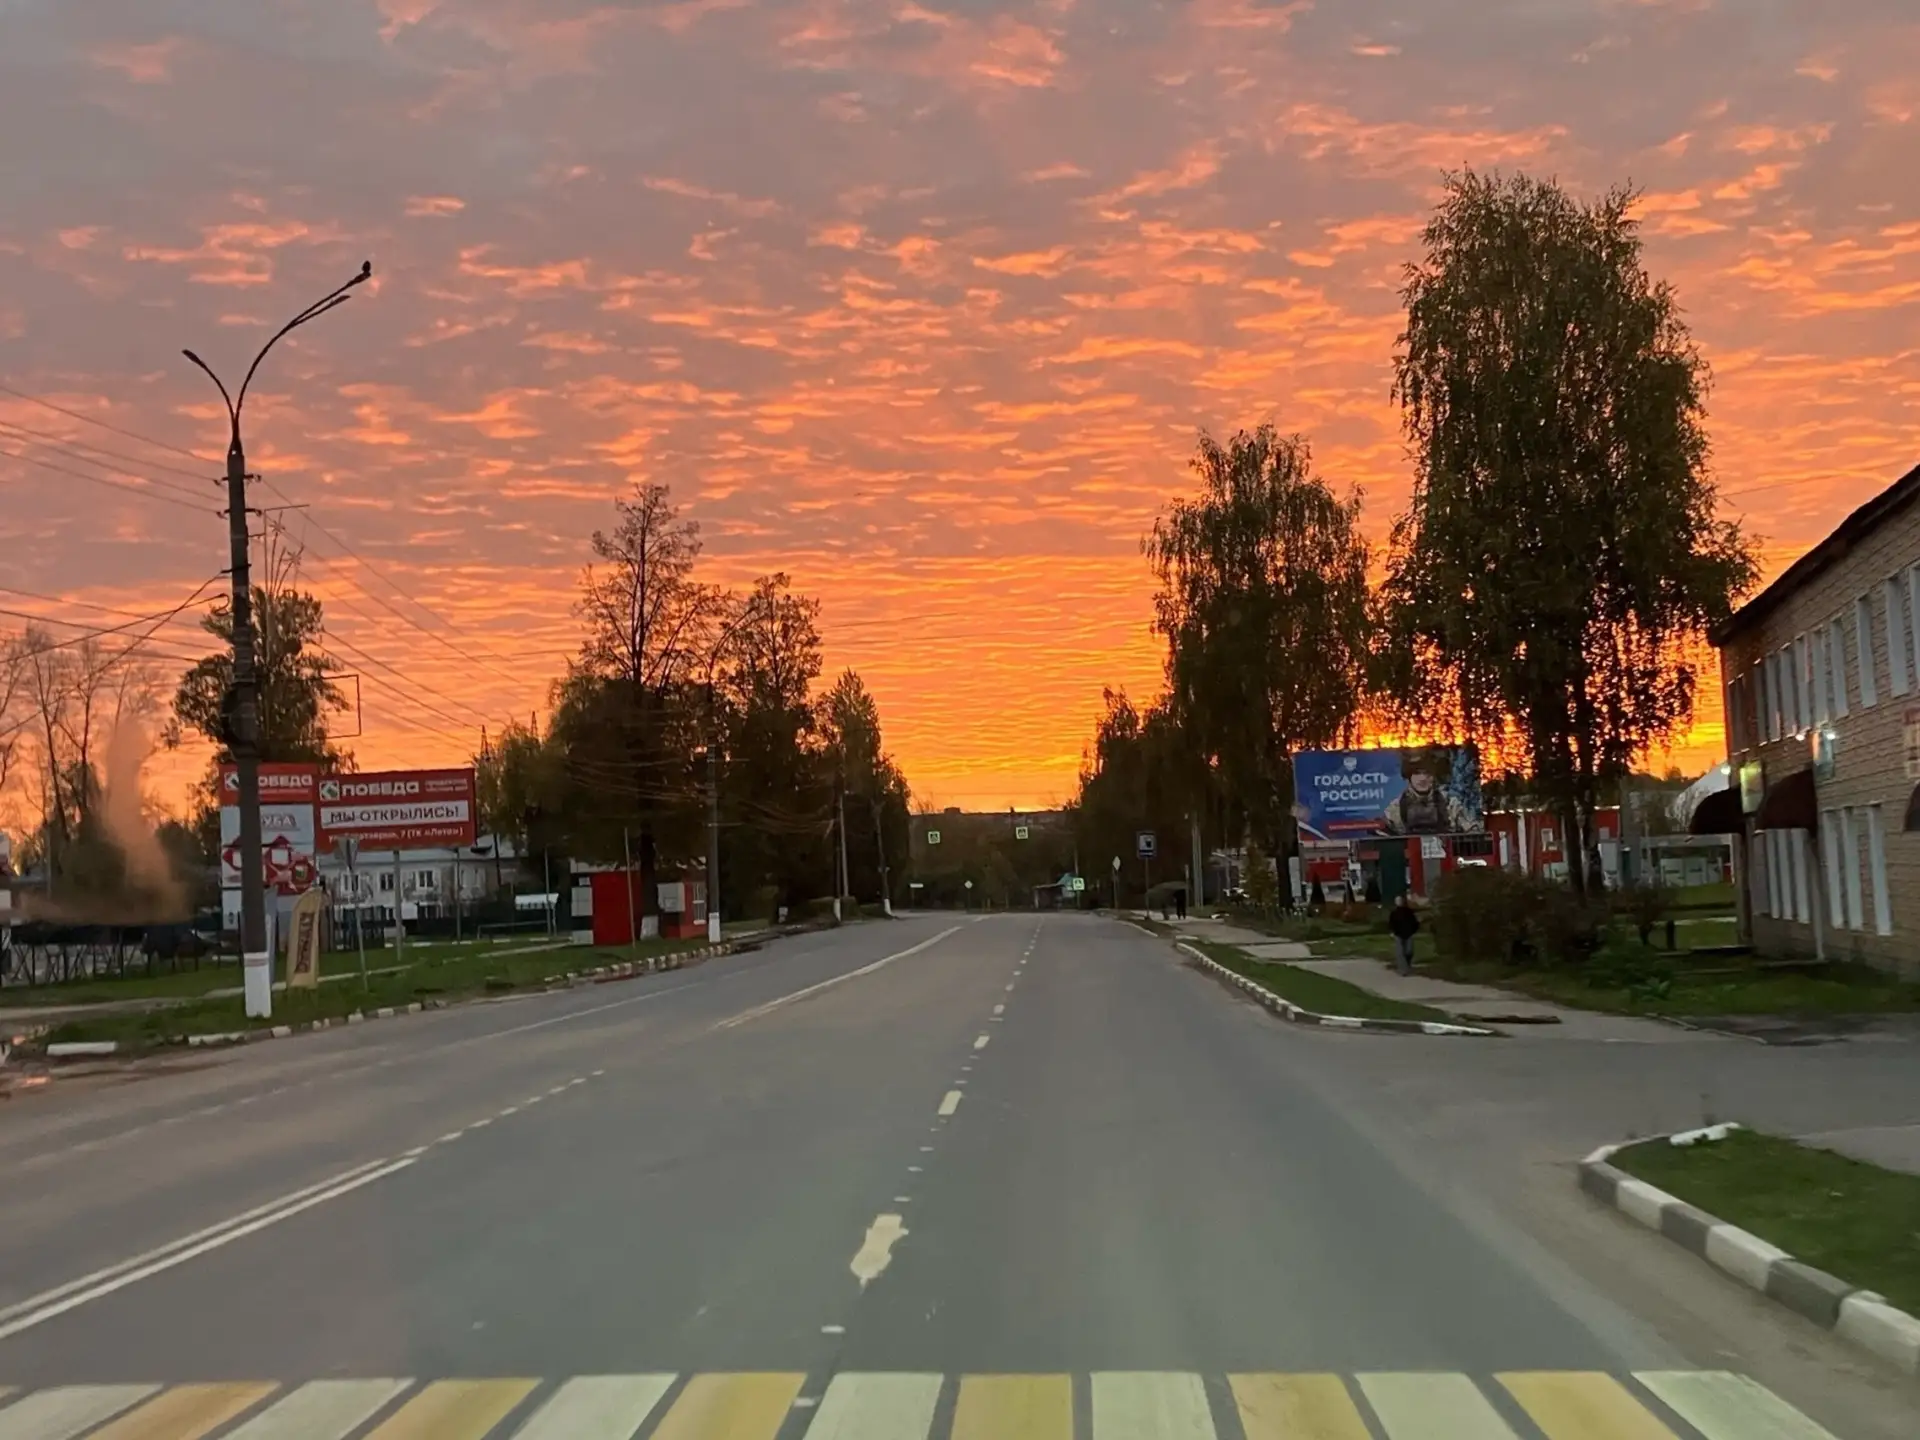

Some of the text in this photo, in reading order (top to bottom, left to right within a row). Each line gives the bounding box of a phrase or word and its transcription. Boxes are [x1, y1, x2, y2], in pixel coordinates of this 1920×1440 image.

[258, 774, 312, 787] ОБЕДА
[1314, 773, 1389, 786] ГОРДОСТЬ
[341, 781, 420, 797] ПОБЕДА
[1320, 788, 1384, 802] РОССИИ!
[330, 806, 460, 823] МЫ ОТКРЫЛИСЬ!
